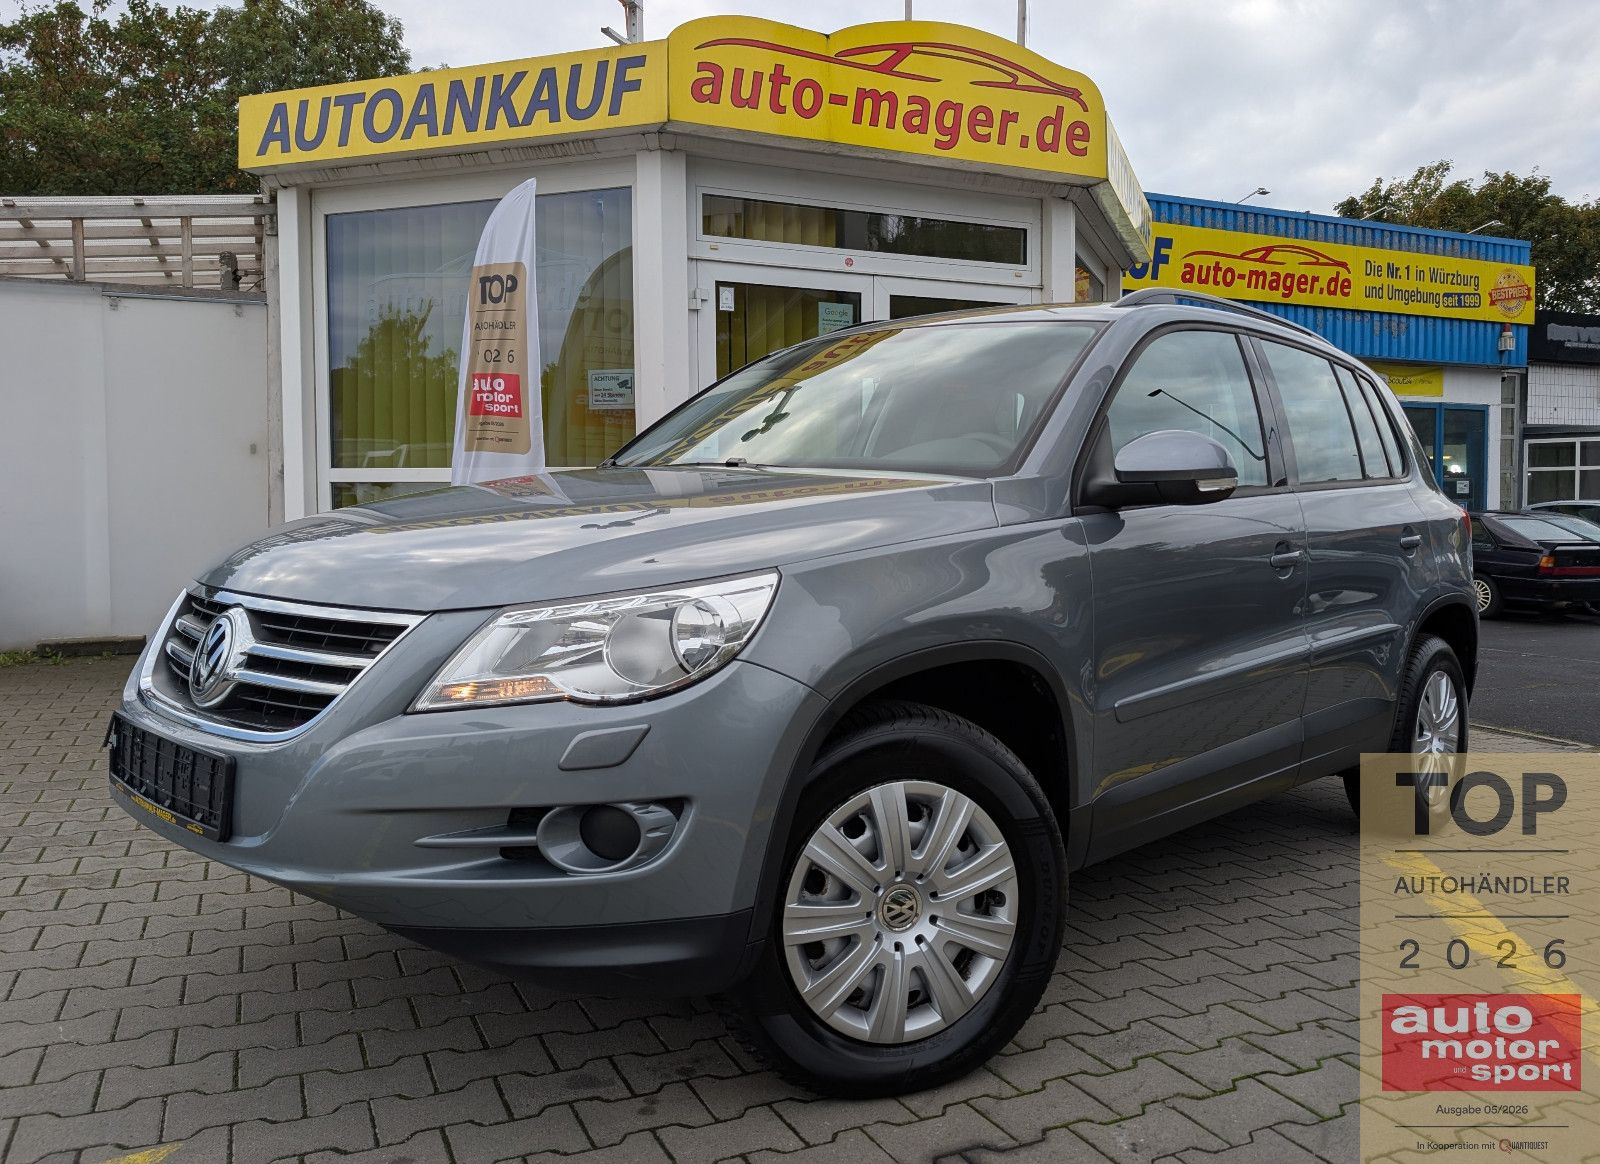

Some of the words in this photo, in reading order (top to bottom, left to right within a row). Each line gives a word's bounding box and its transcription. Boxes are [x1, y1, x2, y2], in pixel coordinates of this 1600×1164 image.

[256, 55, 647, 157] AUTOANKAUF
[690, 60, 1091, 158] auto-mager.de
[479, 273, 518, 305] TOP
[1181, 260, 1352, 298] auto-mager.de
[1365, 259, 1383, 278] Die
[1386, 262, 1402, 279] Nr.
[1404, 264, 1411, 280] 1
[1415, 265, 1425, 282] in
[1429, 266, 1480, 291] Würzburg
[1365, 283, 1384, 300] und
[1387, 284, 1441, 308] Umgebung
[1443, 294, 1459, 307] seit
[1461, 294, 1480, 307] 1999
[824, 307, 849, 317] Google
[485, 403, 519, 414] sport
